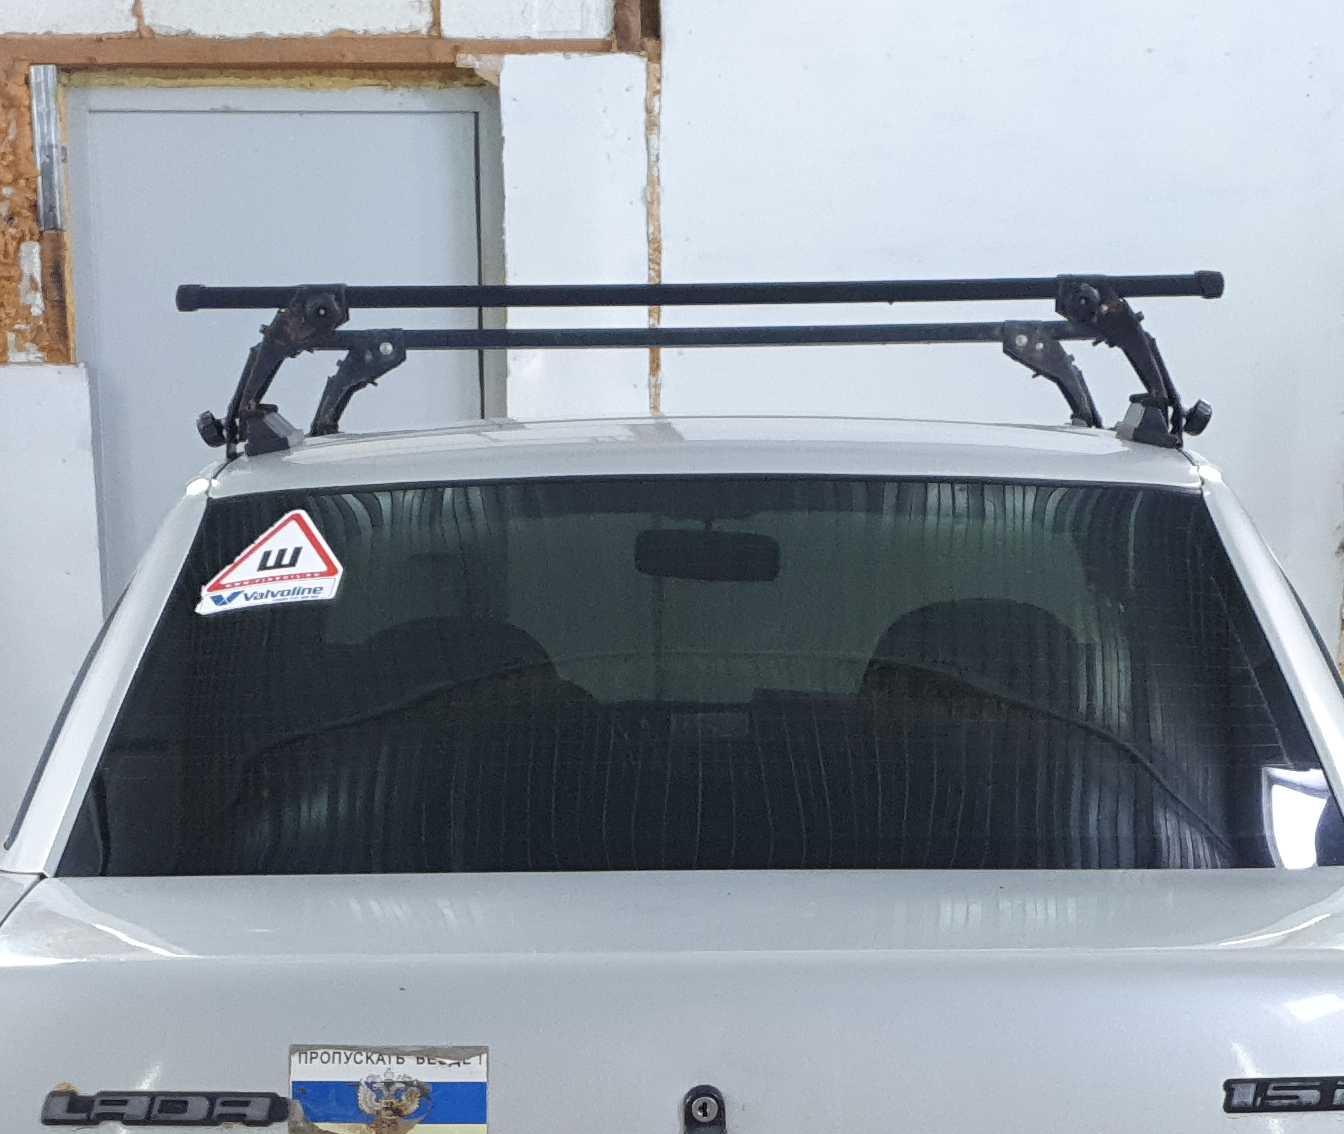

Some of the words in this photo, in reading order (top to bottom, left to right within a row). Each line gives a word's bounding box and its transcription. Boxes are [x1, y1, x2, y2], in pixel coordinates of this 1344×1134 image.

[256, 546, 303, 572] Ш
[243, 586, 324, 602] Valvoline
[298, 1052, 405, 1065] ПРОПУСКАТЬ
[44, 1093, 269, 1123] LADA
